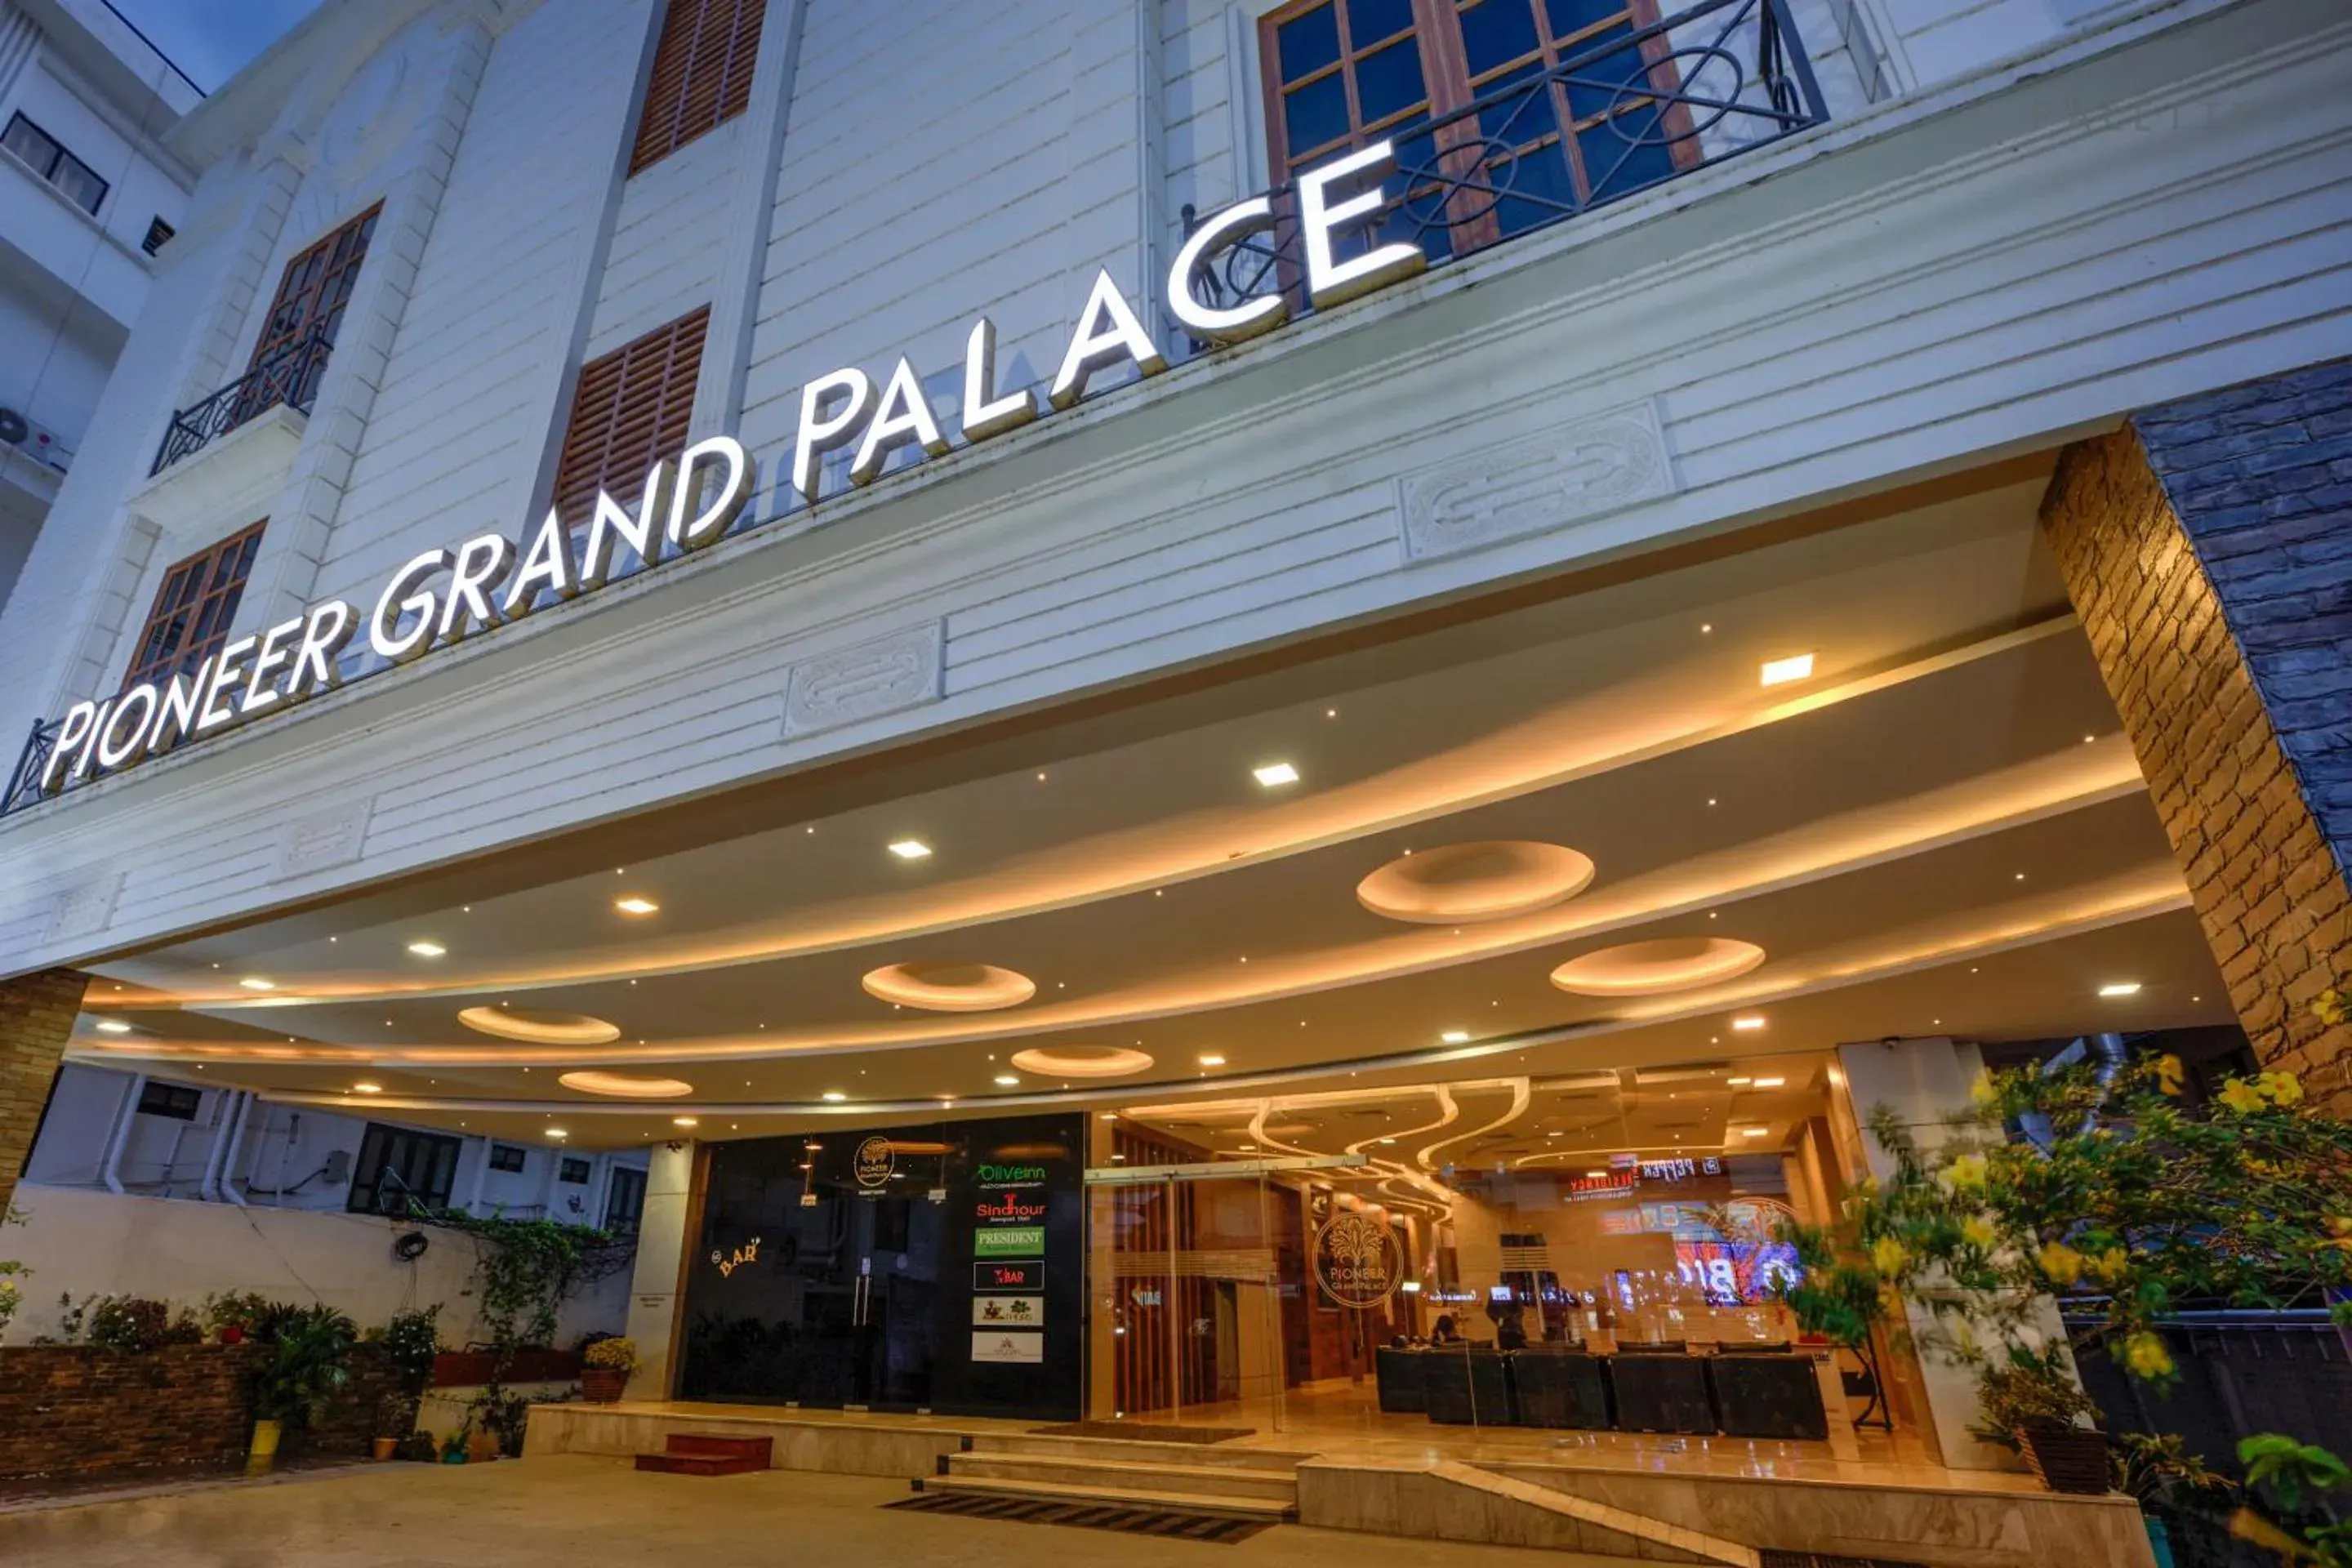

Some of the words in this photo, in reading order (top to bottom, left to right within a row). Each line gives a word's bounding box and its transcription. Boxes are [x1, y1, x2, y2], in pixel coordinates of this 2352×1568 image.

[42, 599, 354, 792] PIONEER
[370, 435, 750, 660] GRAND
[792, 139, 1424, 498] PALACE
[719, 1245, 758, 1279] BAR
[1330, 1267, 1386, 1281] PIONEER
